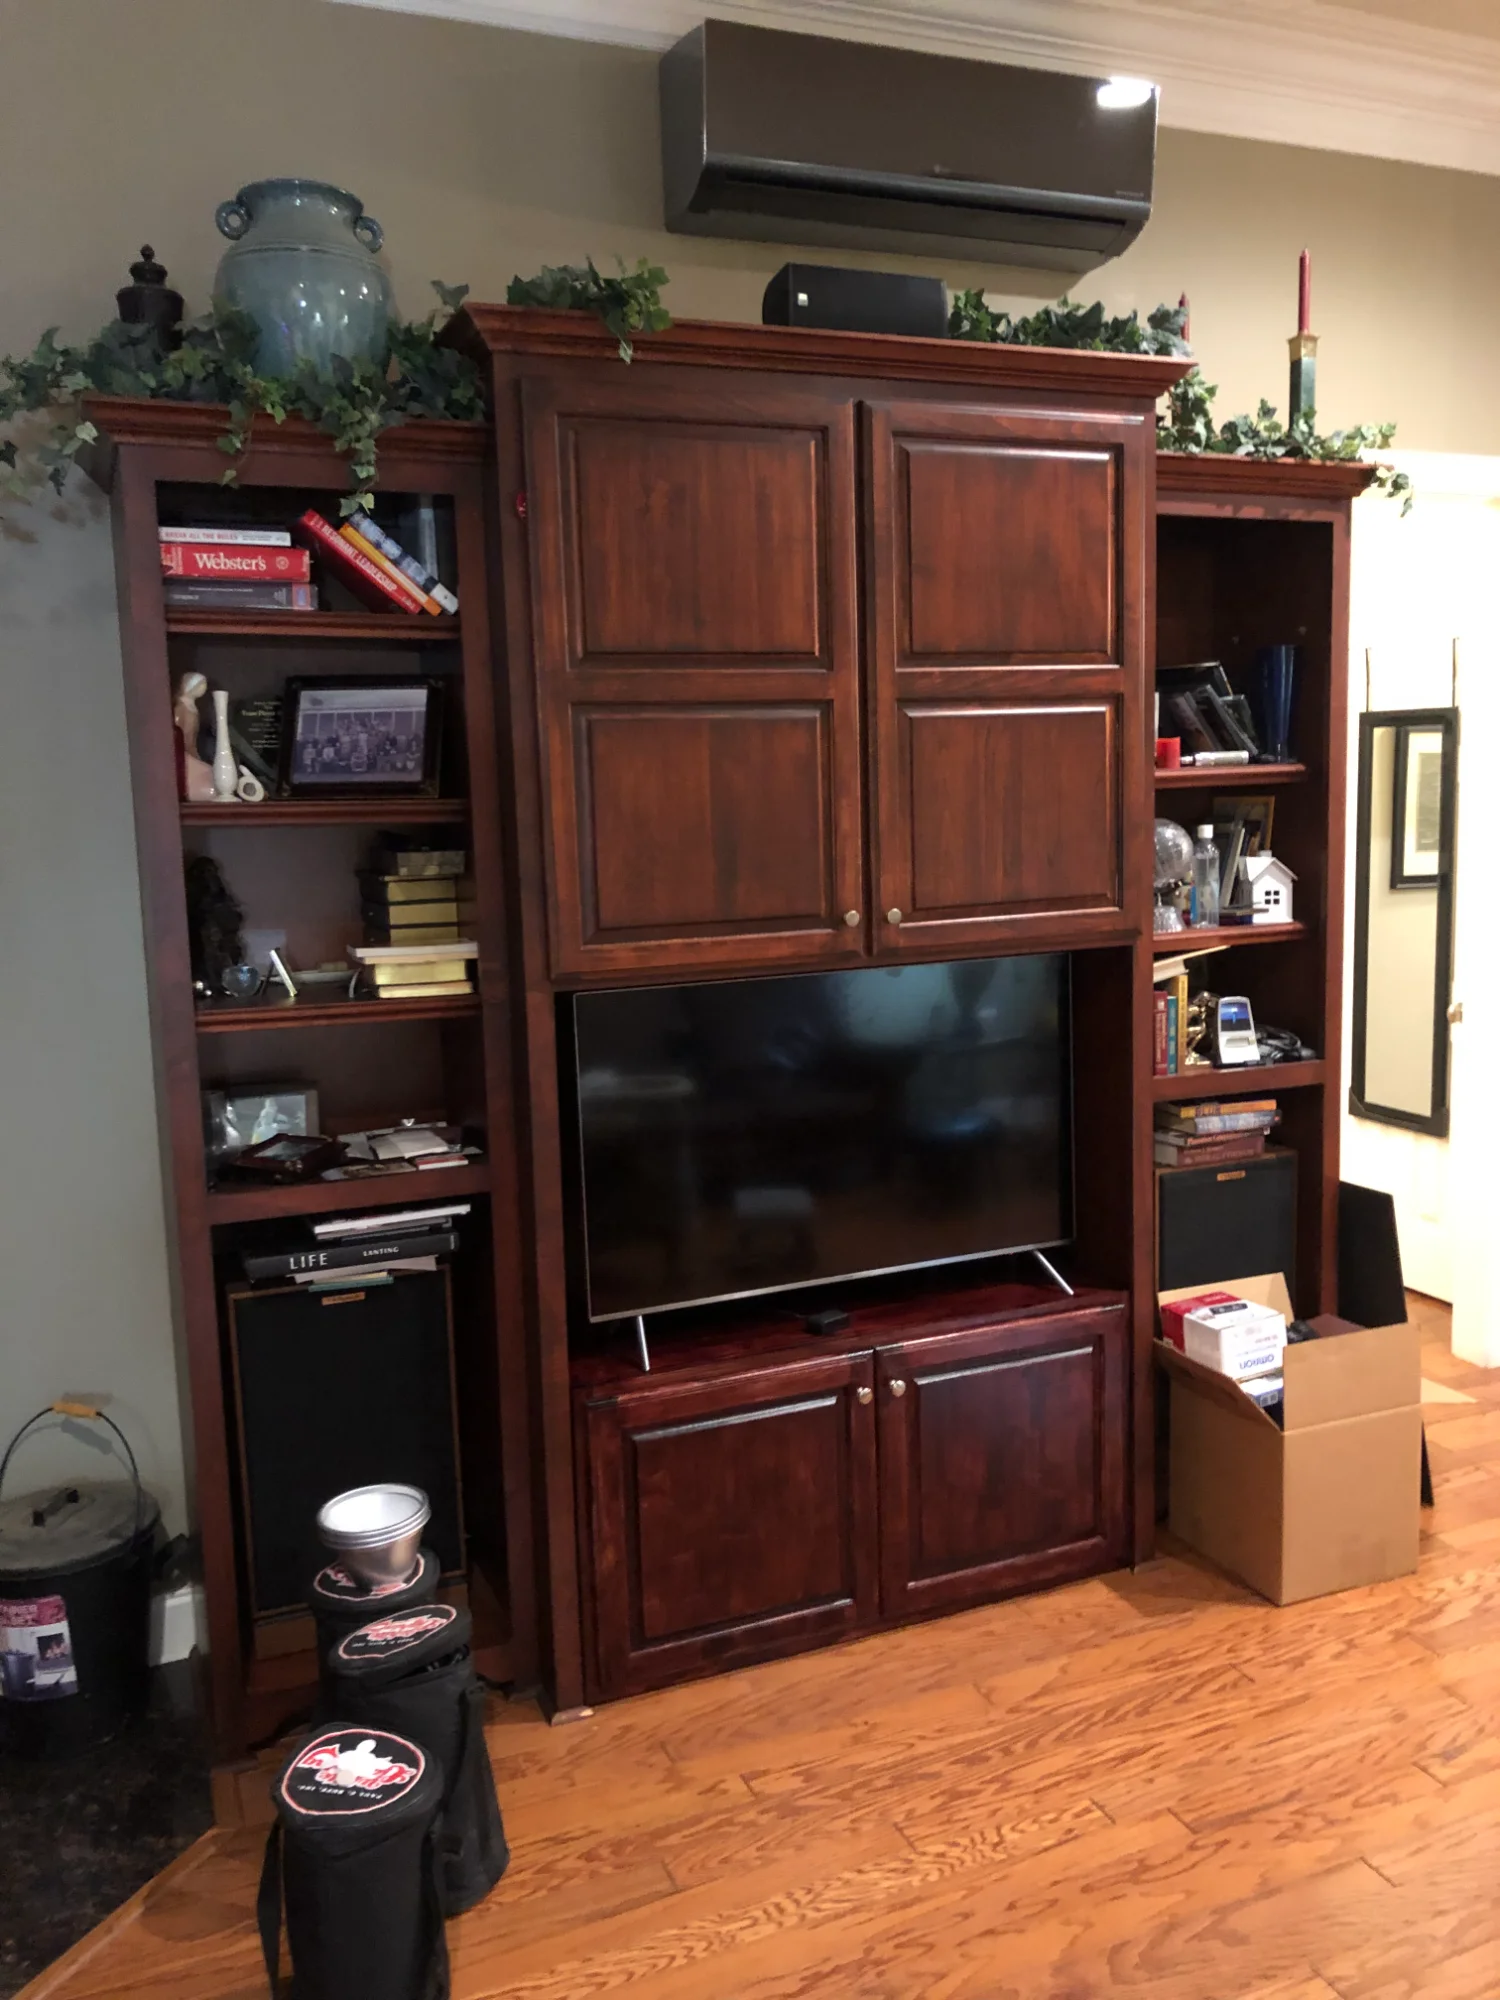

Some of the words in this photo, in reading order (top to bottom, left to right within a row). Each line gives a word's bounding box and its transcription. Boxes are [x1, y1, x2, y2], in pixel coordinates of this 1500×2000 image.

[193, 551, 267, 571] Webster's
[355, 554, 398, 594] LEADERSHIP
[289, 1253, 328, 1270] LIFE
[363, 1246, 399, 1257] LANTING
[1239, 1353, 1275, 1370] omron
